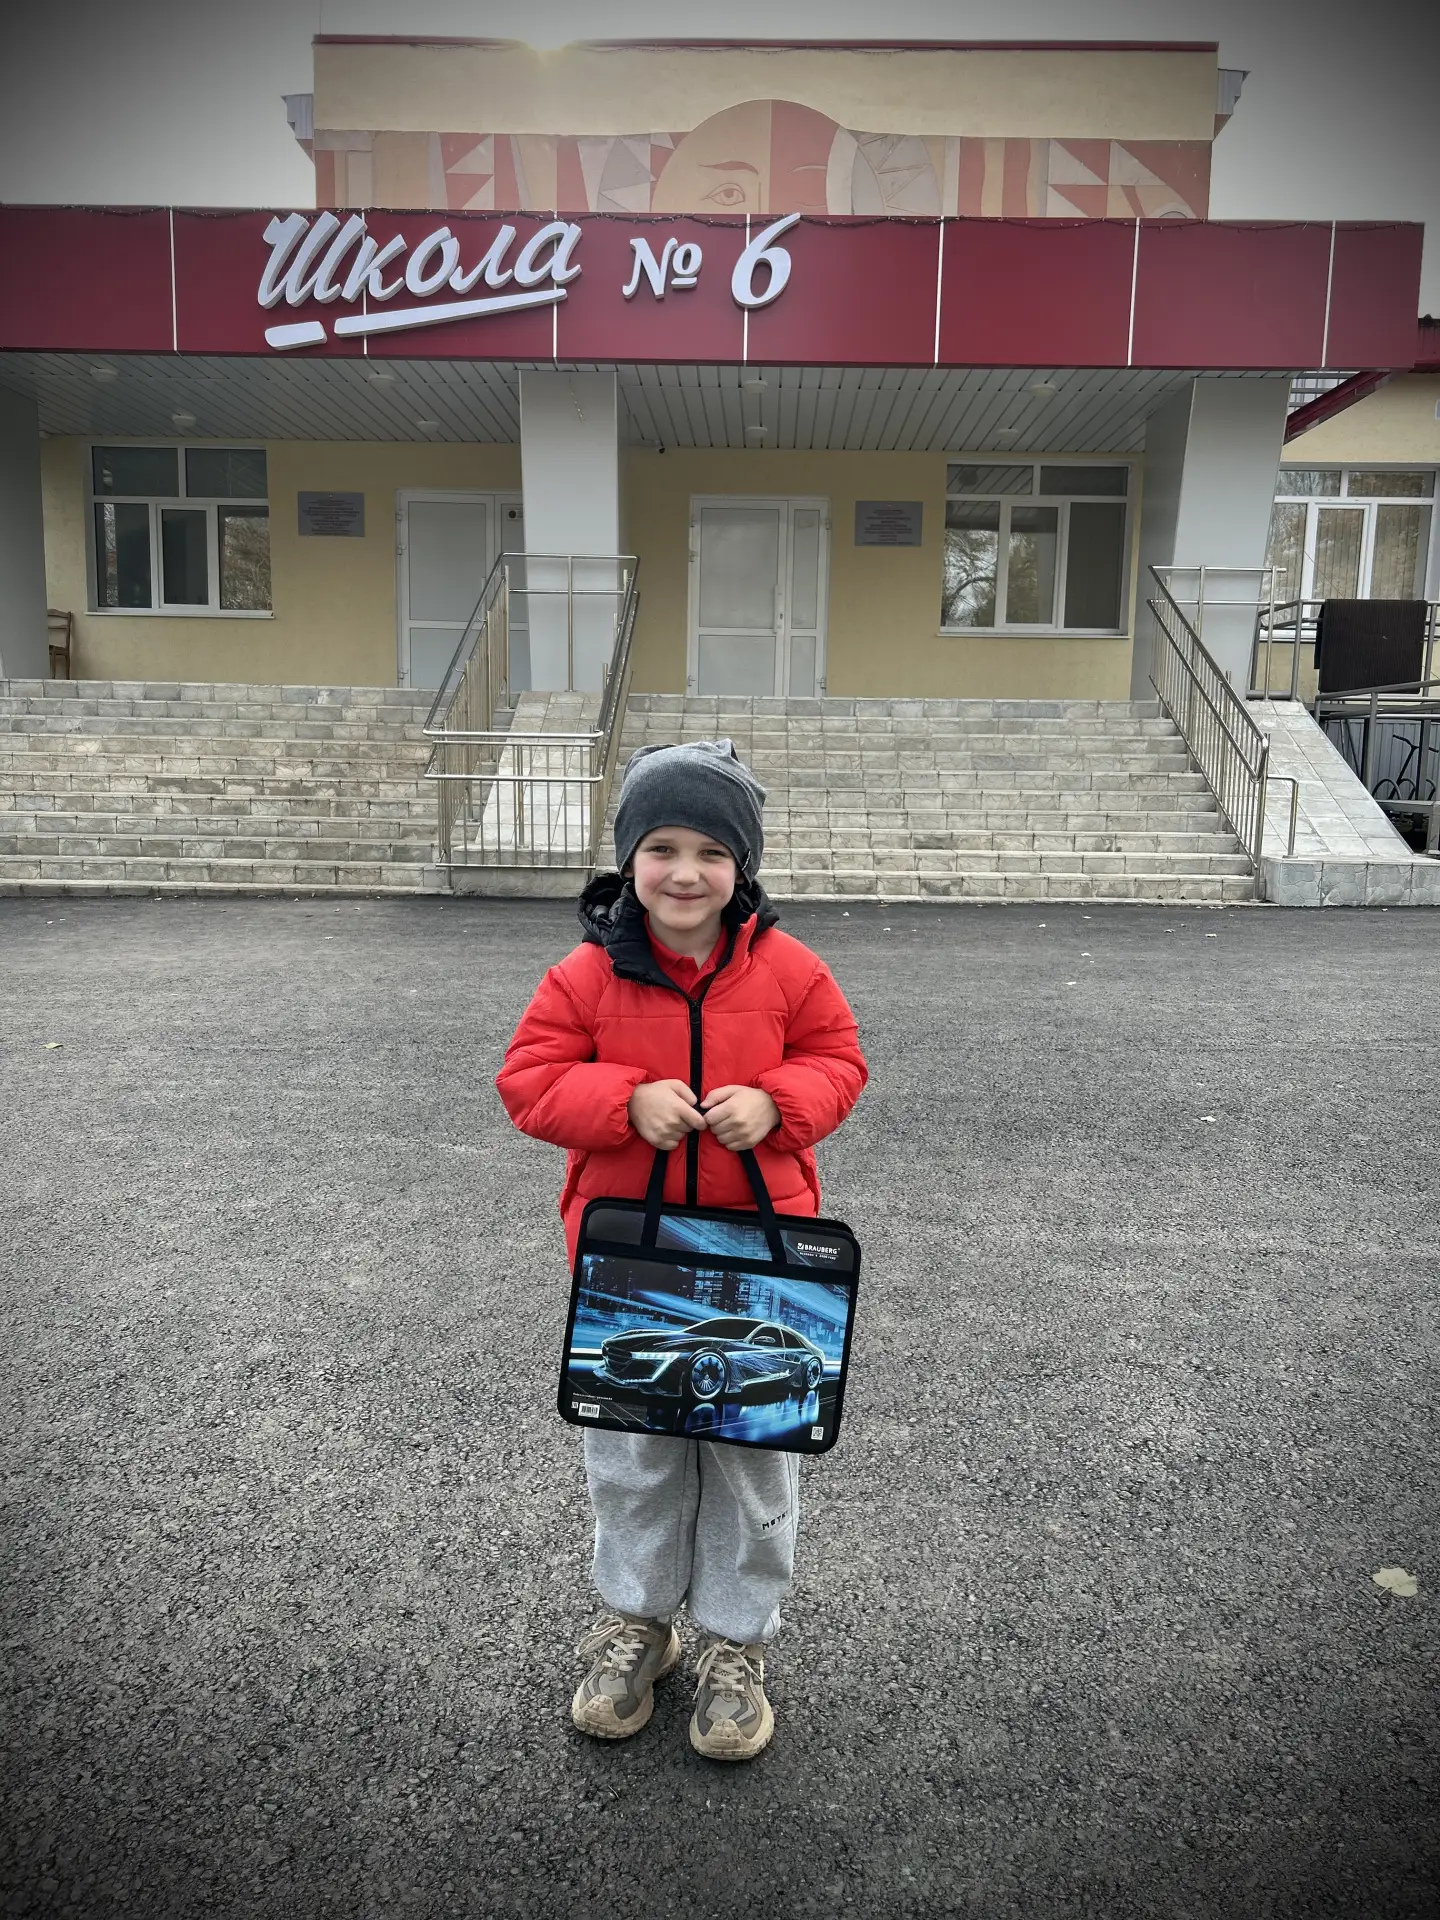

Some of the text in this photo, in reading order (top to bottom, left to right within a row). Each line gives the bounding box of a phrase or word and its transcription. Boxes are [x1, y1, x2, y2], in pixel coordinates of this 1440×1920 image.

[257, 211, 801, 309] Школа № 6
[804, 1244, 838, 1254] BRAUBERG
